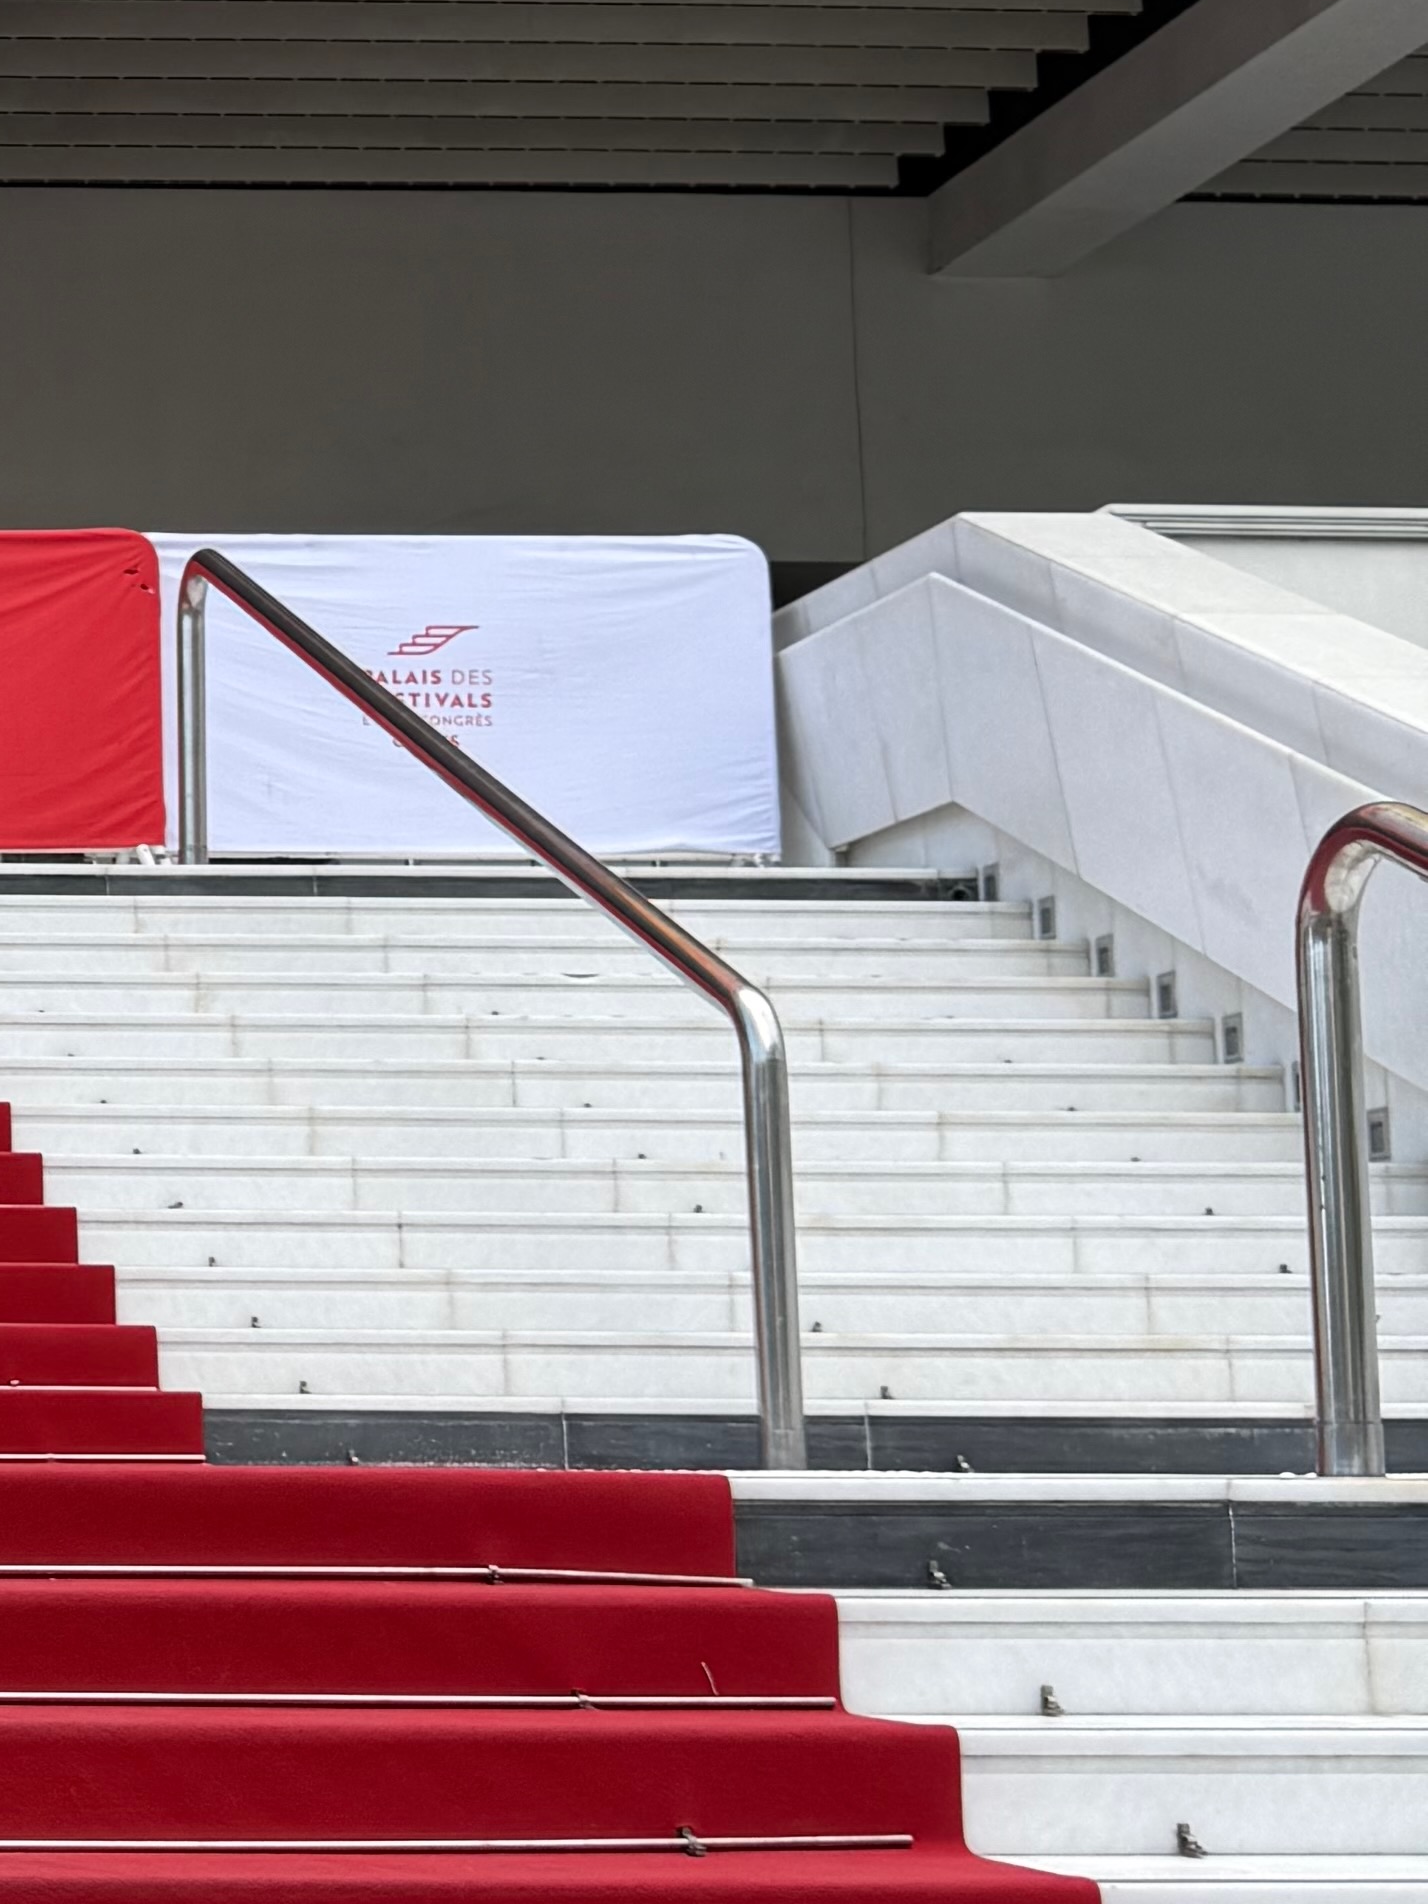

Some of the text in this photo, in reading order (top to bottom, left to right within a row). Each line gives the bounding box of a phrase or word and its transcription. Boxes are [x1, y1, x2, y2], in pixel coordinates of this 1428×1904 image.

[365, 669, 493, 685] ALAIS DES
[429, 713, 493, 727] ONGRÈS
